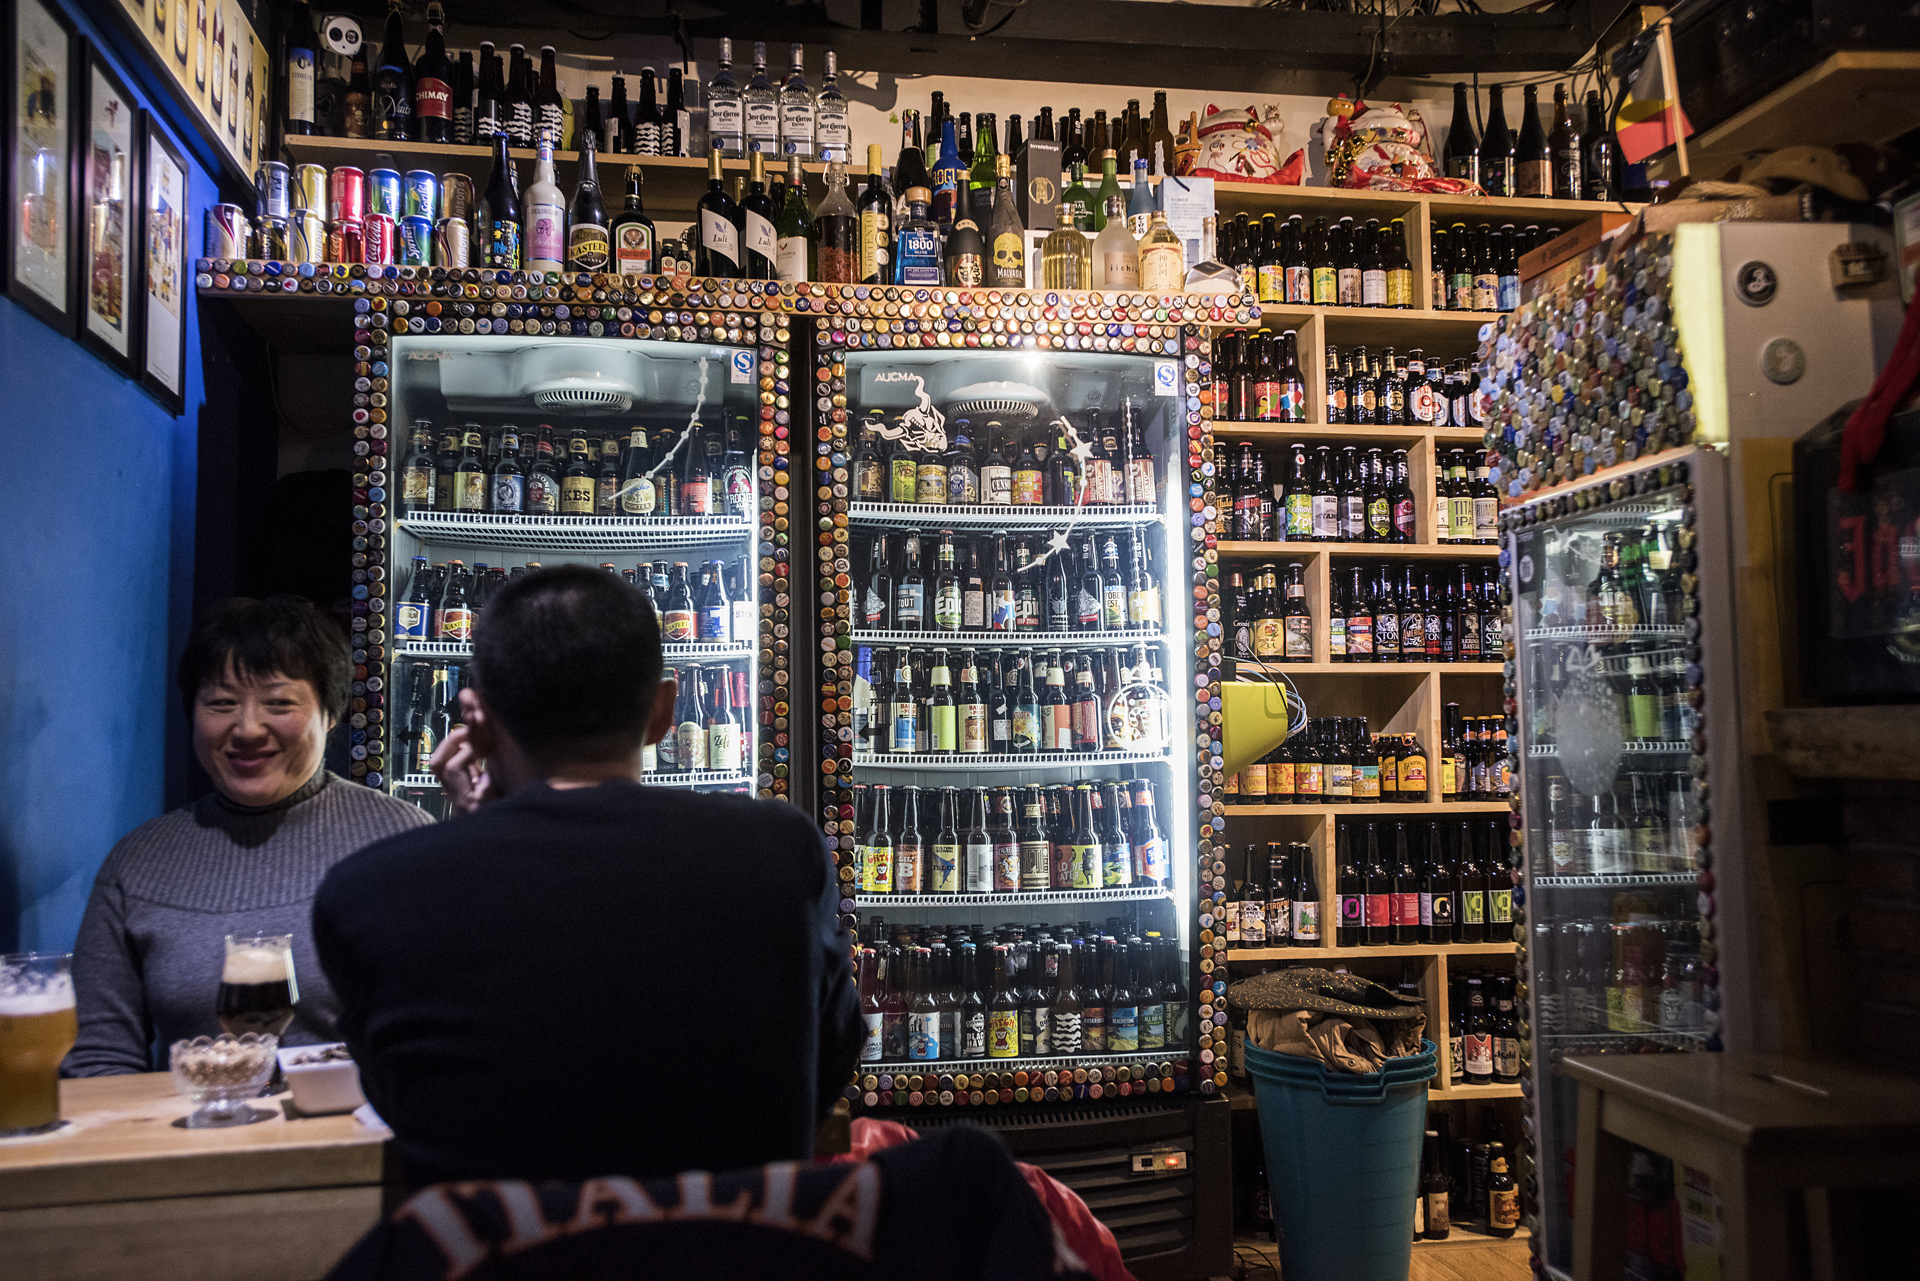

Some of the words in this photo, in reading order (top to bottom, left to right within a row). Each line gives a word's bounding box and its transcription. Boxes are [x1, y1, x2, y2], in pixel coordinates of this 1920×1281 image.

[416, 90, 449, 102] CHIMAY
[932, 168, 958, 185] ROGU
[407, 226, 420, 260] Sprite
[908, 238, 933, 250] 1800
[570, 241, 608, 259] KASTEEL
[997, 268, 1023, 278] MALVASIA
[875, 372, 916, 383] AUCMA
[563, 490, 590, 502] KBS
